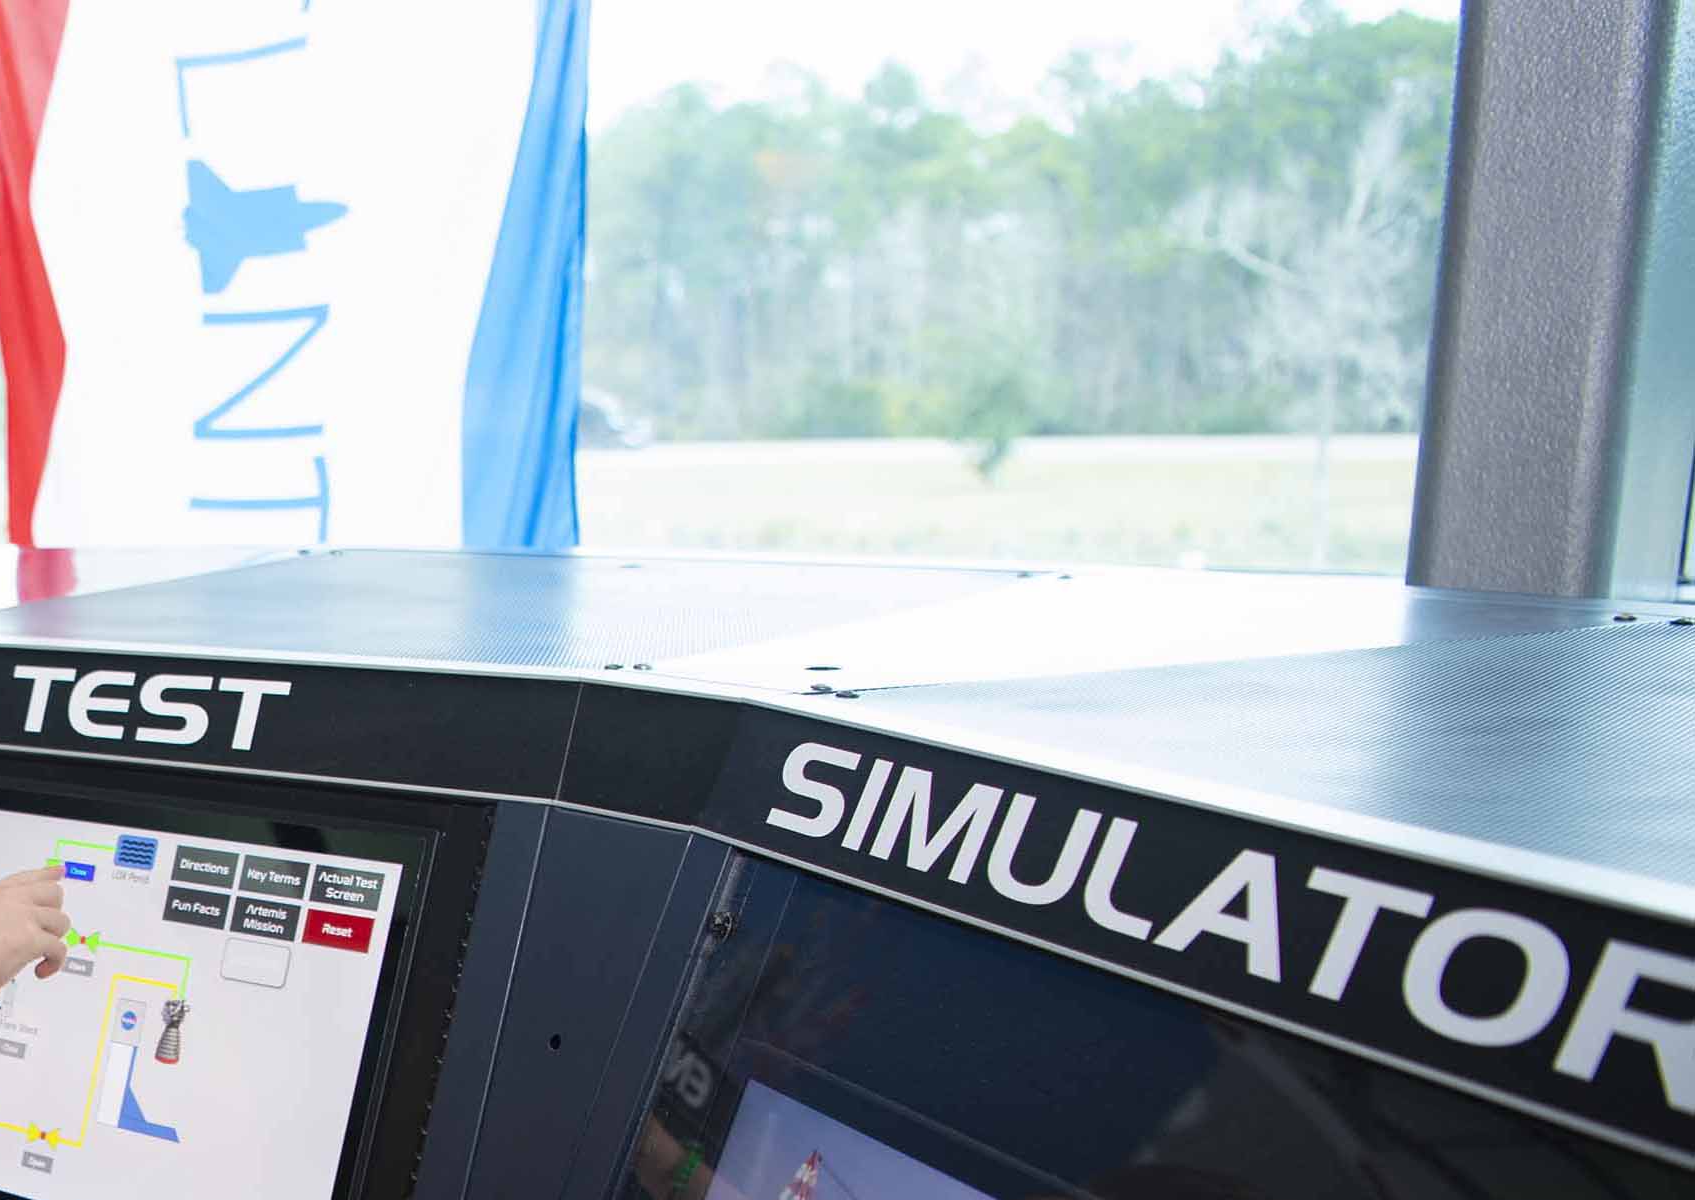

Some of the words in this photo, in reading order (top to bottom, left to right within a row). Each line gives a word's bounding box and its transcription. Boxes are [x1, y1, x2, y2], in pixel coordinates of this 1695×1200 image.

[179, 857, 231, 876] Directions
[246, 867, 267, 885] Key
[269, 871, 302, 887] Terms
[318, 871, 354, 886] Actual
[355, 877, 379, 890] Test
[13, 664, 293, 752] TEST
[766, 741, 1695, 1117] SIMULATOR
[325, 887, 366, 903] Screen
[171, 899, 193, 913] Fun
[193, 902, 221, 918] Facts
[244, 903, 288, 921] Artemis
[242, 917, 285, 935] Mission
[321, 922, 354, 938] Reset
